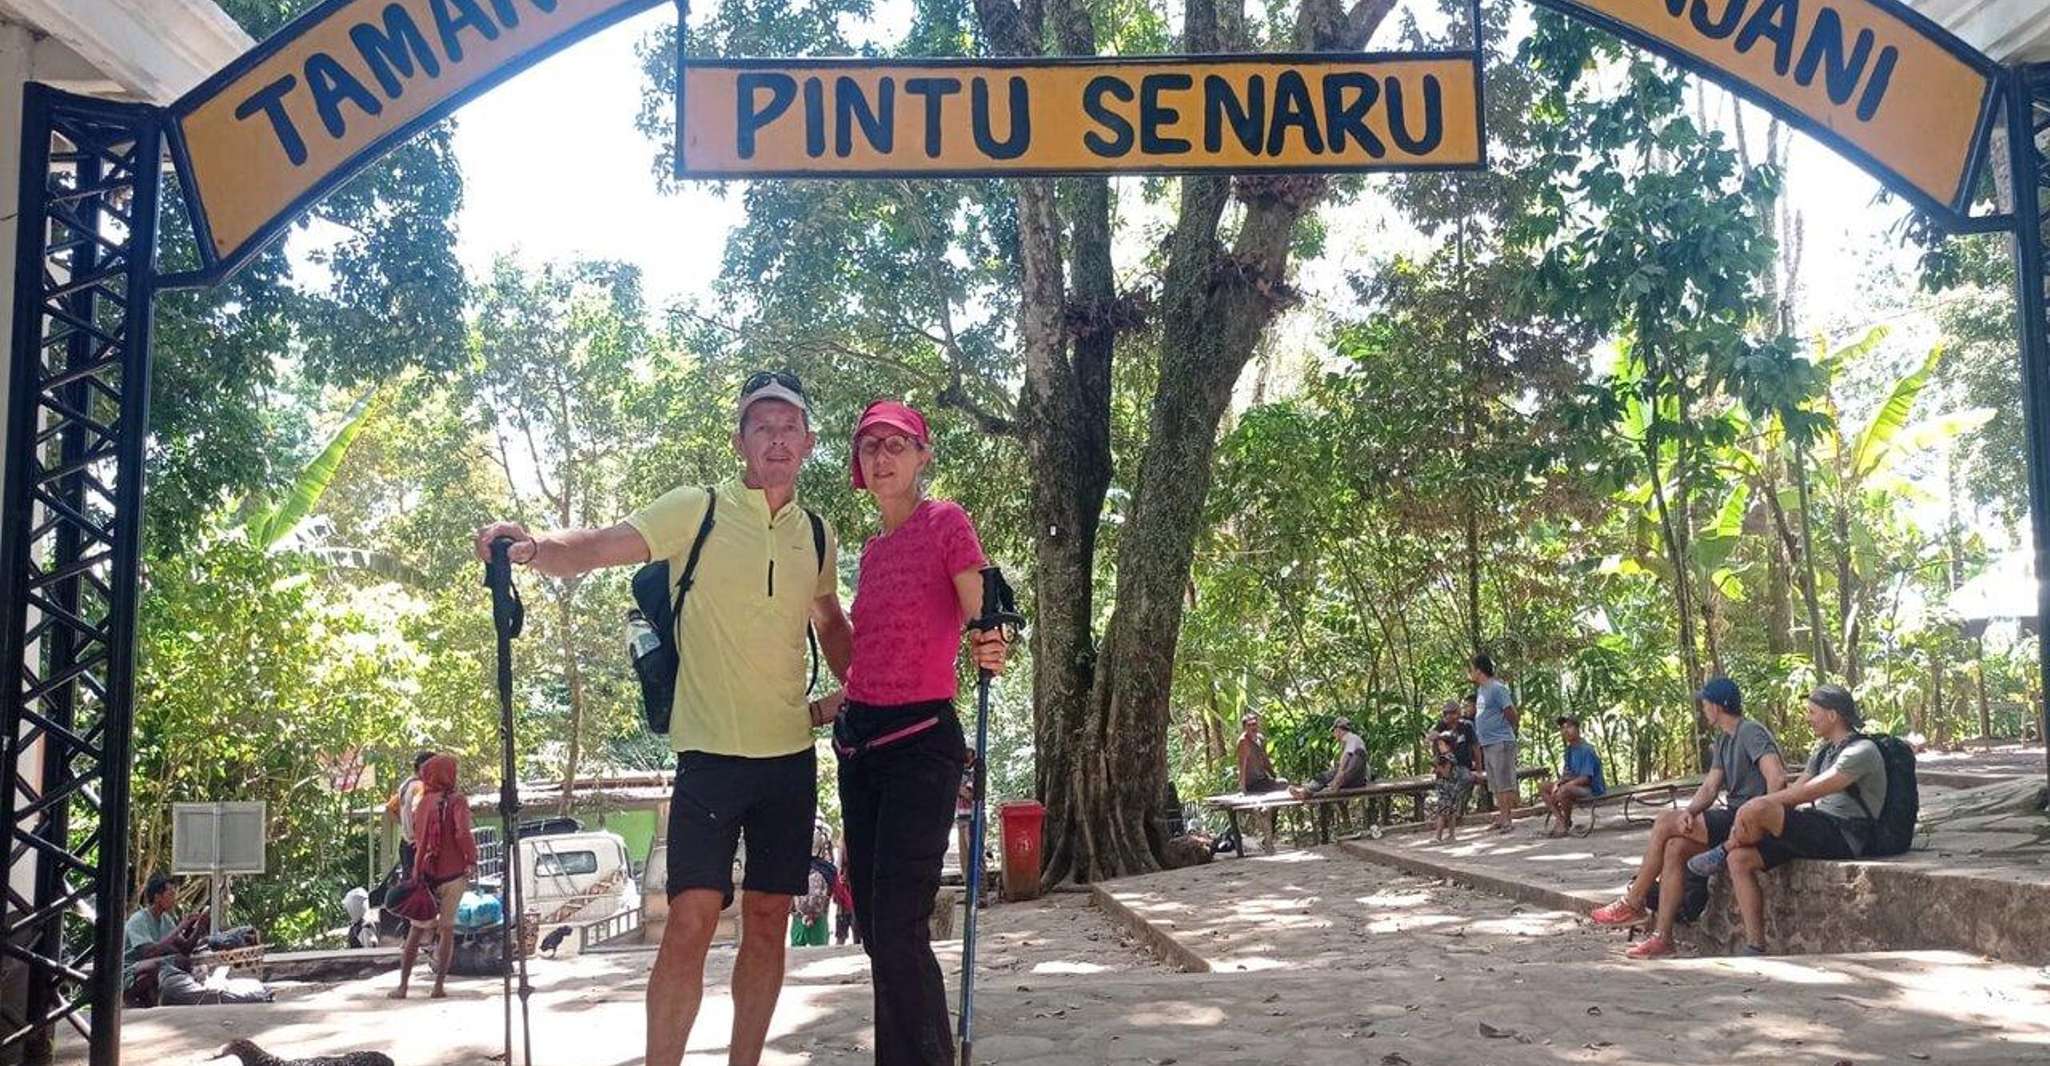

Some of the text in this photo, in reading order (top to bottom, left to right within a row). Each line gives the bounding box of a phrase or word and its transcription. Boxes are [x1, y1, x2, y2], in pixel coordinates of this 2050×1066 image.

[233, 0, 559, 167] TAMA
[736, 69, 1444, 161] PINTU SENARU
